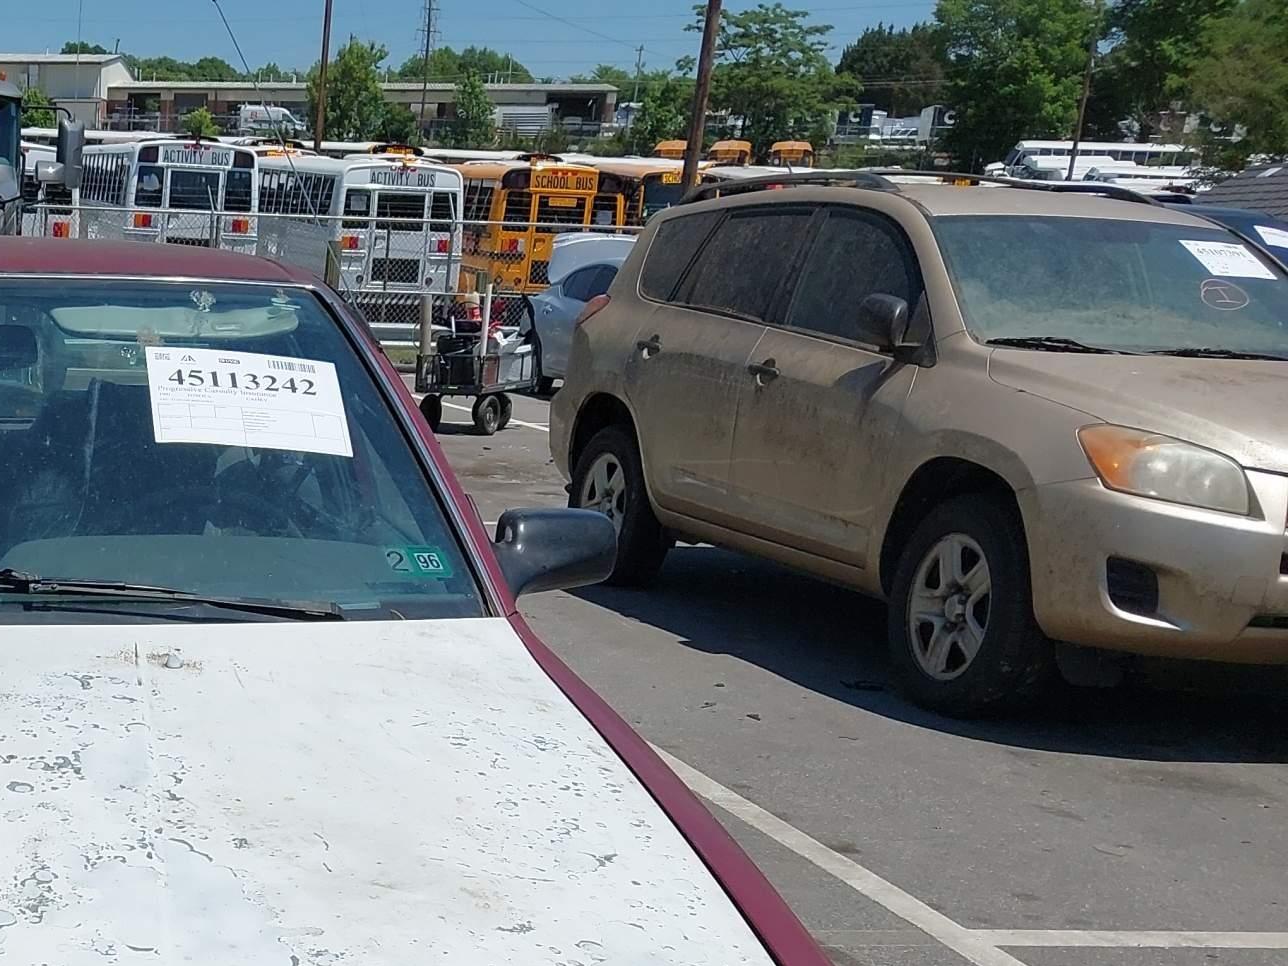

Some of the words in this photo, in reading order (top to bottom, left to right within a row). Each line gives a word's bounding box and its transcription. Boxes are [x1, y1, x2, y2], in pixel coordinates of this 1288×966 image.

[163, 149, 204, 164] ACTIVITY
[211, 152, 230, 166] BUS
[370, 171, 410, 185] ACTIVITY
[417, 173, 436, 187] BUS
[535, 174, 571, 189] SCHOOL
[575, 176, 594, 190] BUS
[168, 368, 317, 396] 45113242
[387, 551, 409, 571] 2
[417, 554, 440, 569] 96
